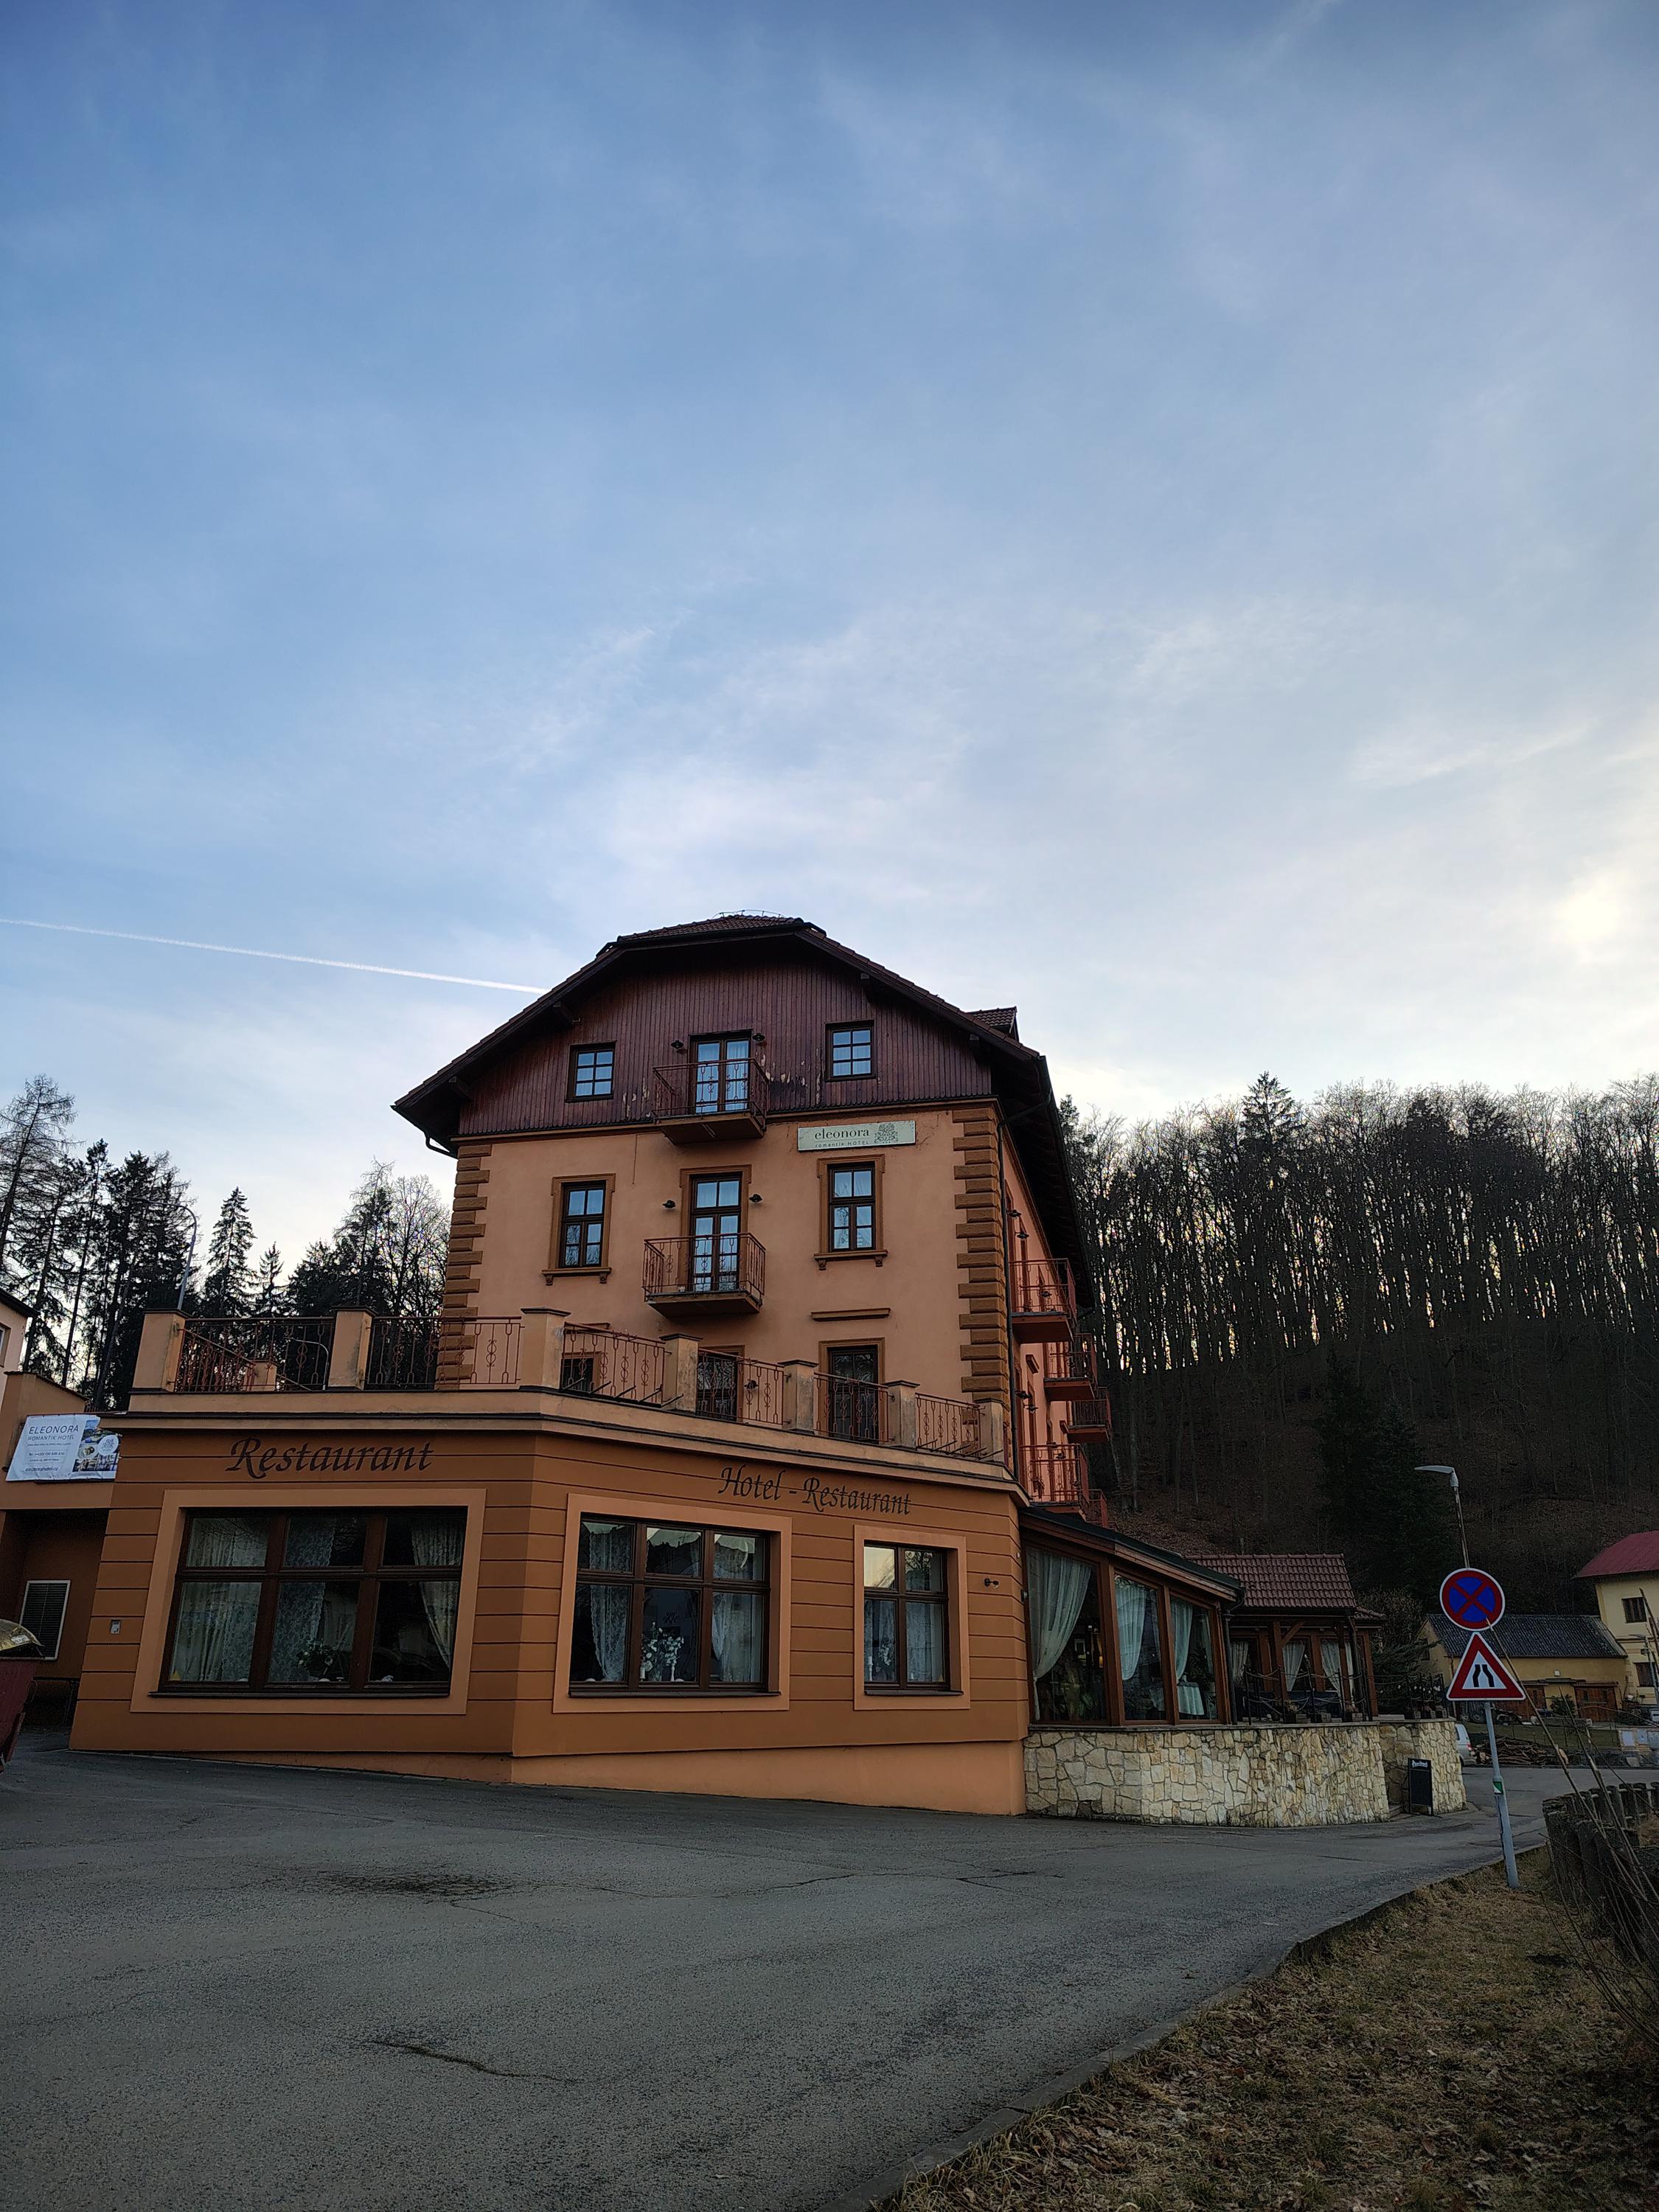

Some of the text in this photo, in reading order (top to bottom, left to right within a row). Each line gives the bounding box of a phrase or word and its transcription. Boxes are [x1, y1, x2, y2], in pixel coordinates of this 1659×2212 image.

[815, 1128, 869, 1140] eleonora
[28, 1425, 79, 1434] ELEONORA
[225, 1438, 434, 1479] Restaurant
[717, 1464, 786, 1501] Hotel
[801, 1476, 911, 1515] Restaurant
